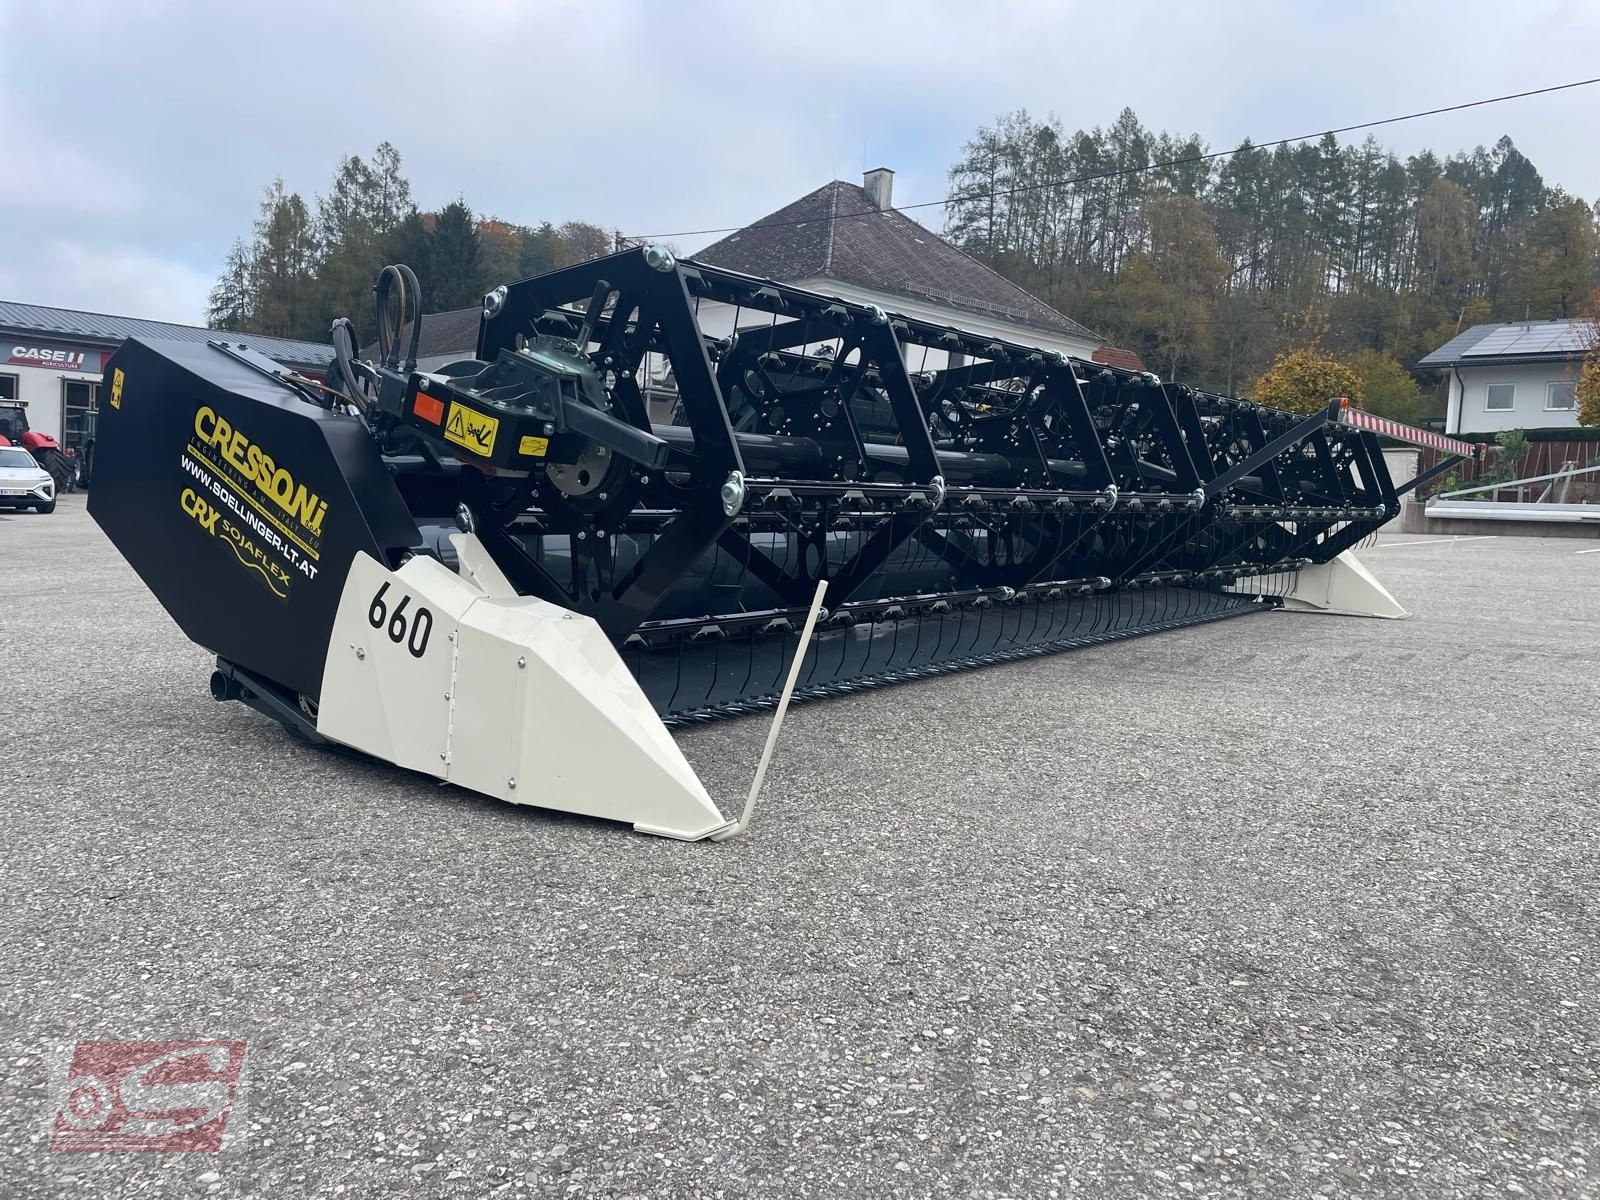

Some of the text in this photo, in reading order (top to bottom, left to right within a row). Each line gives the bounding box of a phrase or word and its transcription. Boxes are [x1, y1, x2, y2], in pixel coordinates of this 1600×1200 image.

[12, 346, 66, 362] CASE
[42, 361, 78, 369] AGRICULTURE
[190, 436, 249, 489] ENGINEERING
[277, 511, 299, 532] ITALY
[181, 488, 221, 536] CRX
[221, 519, 291, 586] SOJAFLEX
[368, 581, 433, 659] 660
